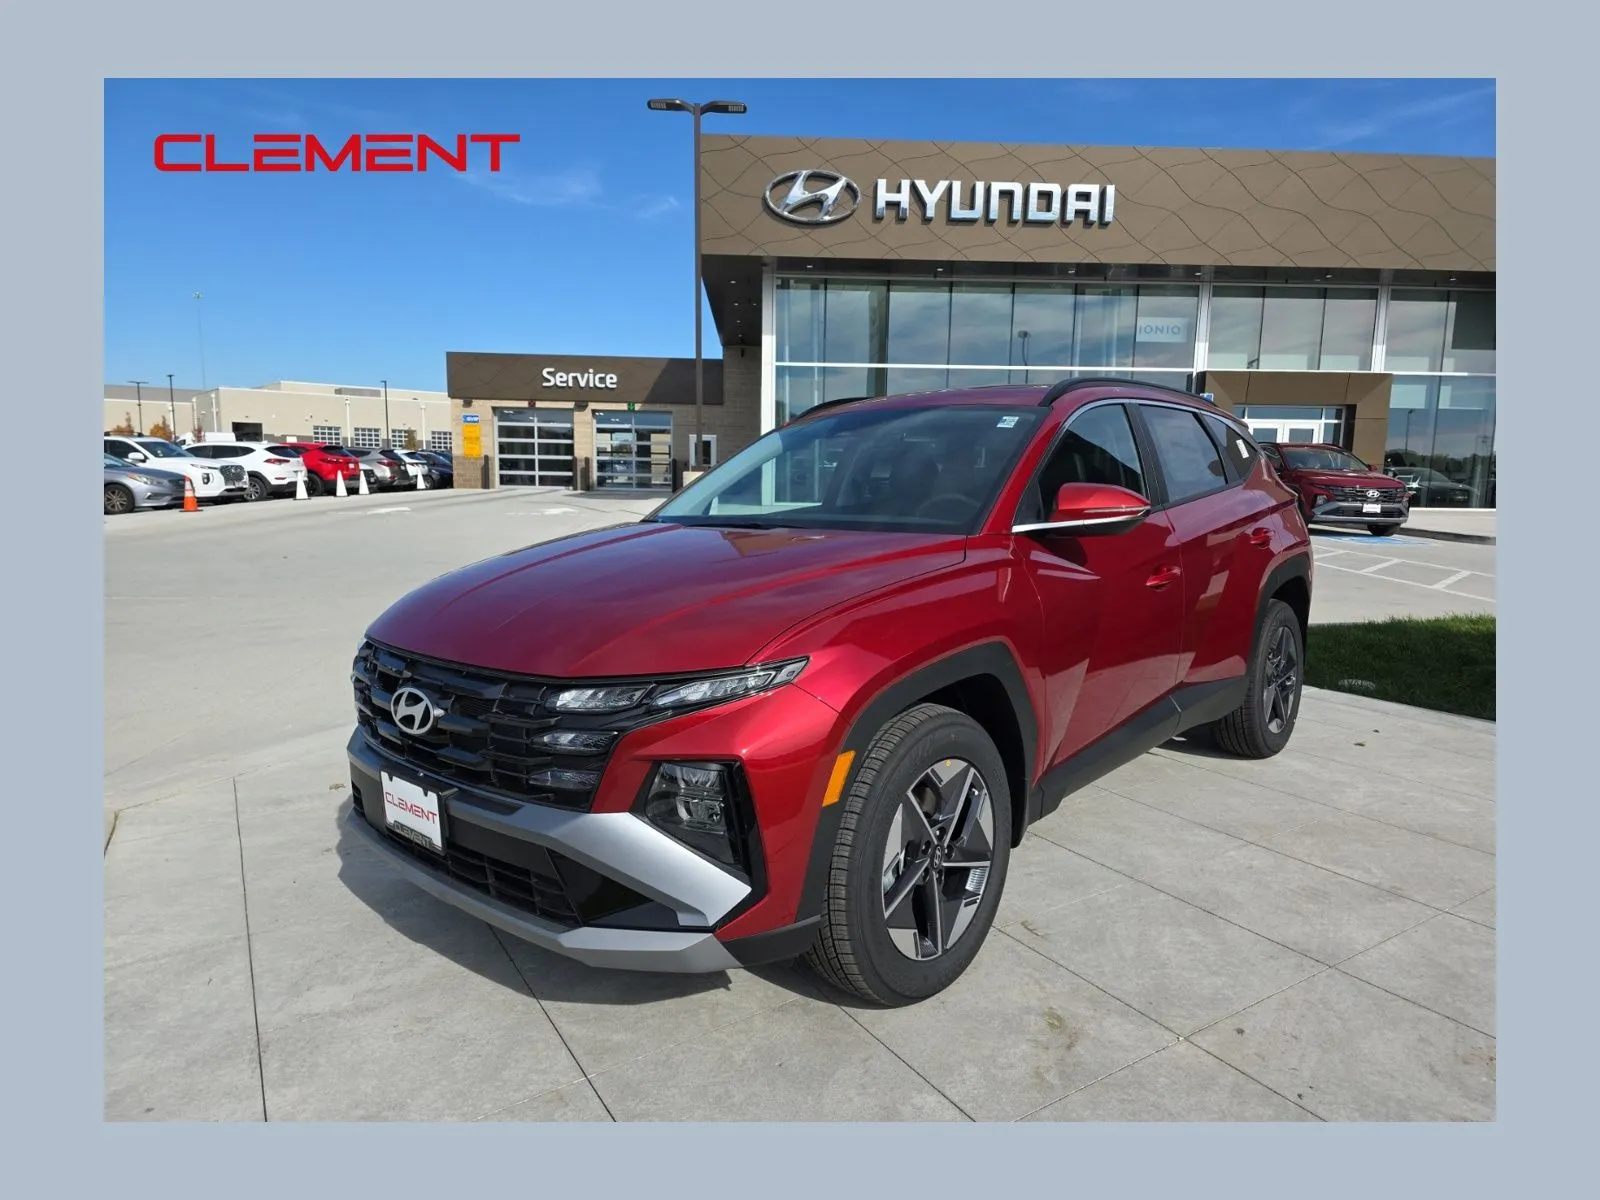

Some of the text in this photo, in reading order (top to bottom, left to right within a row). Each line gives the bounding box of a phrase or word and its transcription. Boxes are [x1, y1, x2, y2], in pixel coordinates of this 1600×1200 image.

[875, 178, 1116, 228] HYUNDAI
[541, 367, 618, 390] Service
[384, 791, 438, 825] CLEMENT
